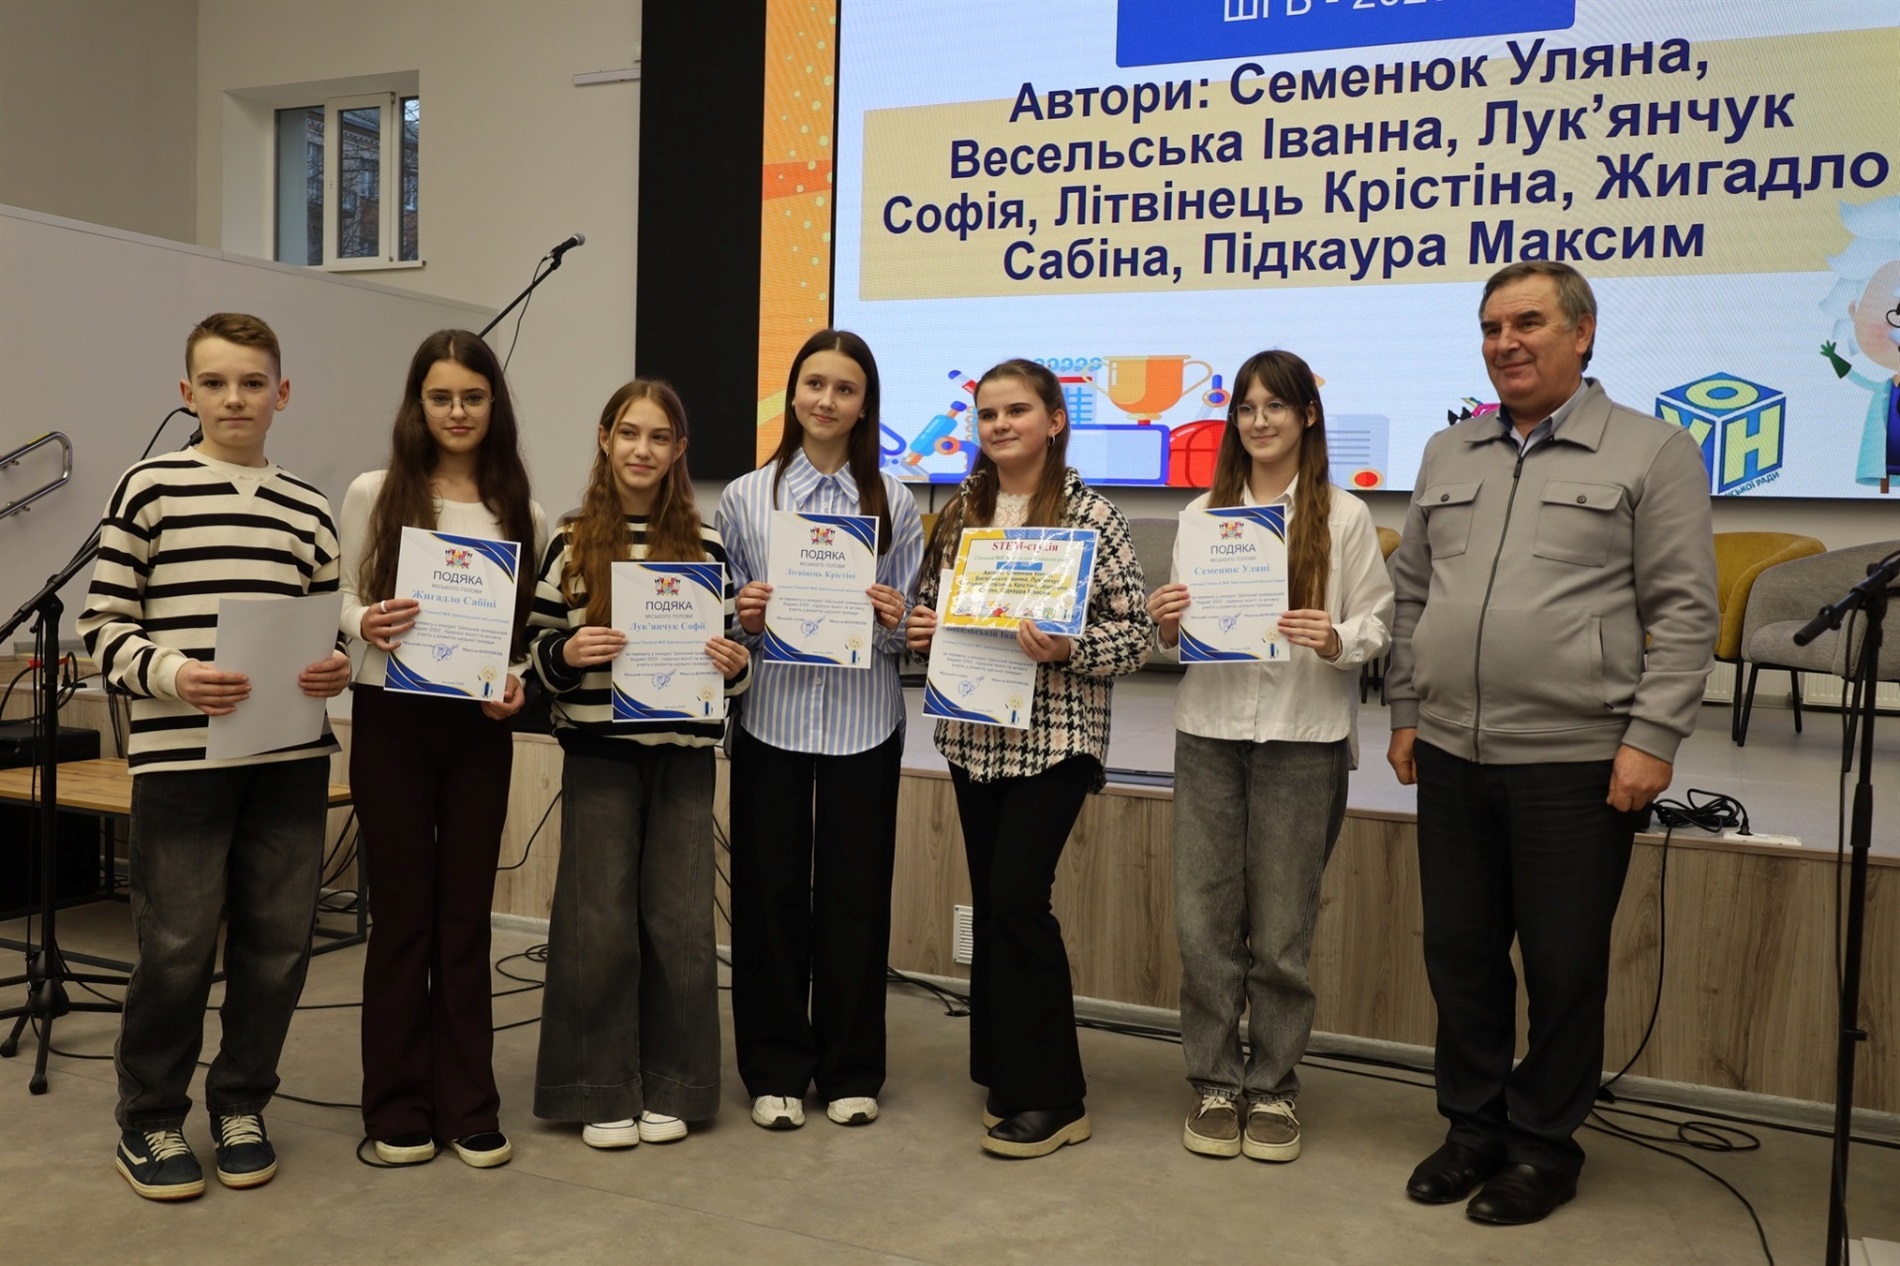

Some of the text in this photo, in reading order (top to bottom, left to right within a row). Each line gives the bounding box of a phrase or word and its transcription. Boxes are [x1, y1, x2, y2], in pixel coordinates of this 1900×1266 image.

[1008, 36, 1709, 124] Автори: Семенюк Уляна,
[951, 131, 1243, 179] Весельська
[1264, 117, 1458, 160] Іванна,
[883, 151, 1889, 241] Софія, Літвінець Крістіна, Жигадло
[1004, 219, 1704, 284] Сабіна, Підкаура Максим
[800, 549, 846, 561] ПОДЯКА
[1210, 543, 1257, 555] ПОДЯКА
[433, 570, 483, 586] ПОДЯКА
[1194, 565, 1240, 576] Семенюк
[645, 601, 693, 612] ПОДЯКА
